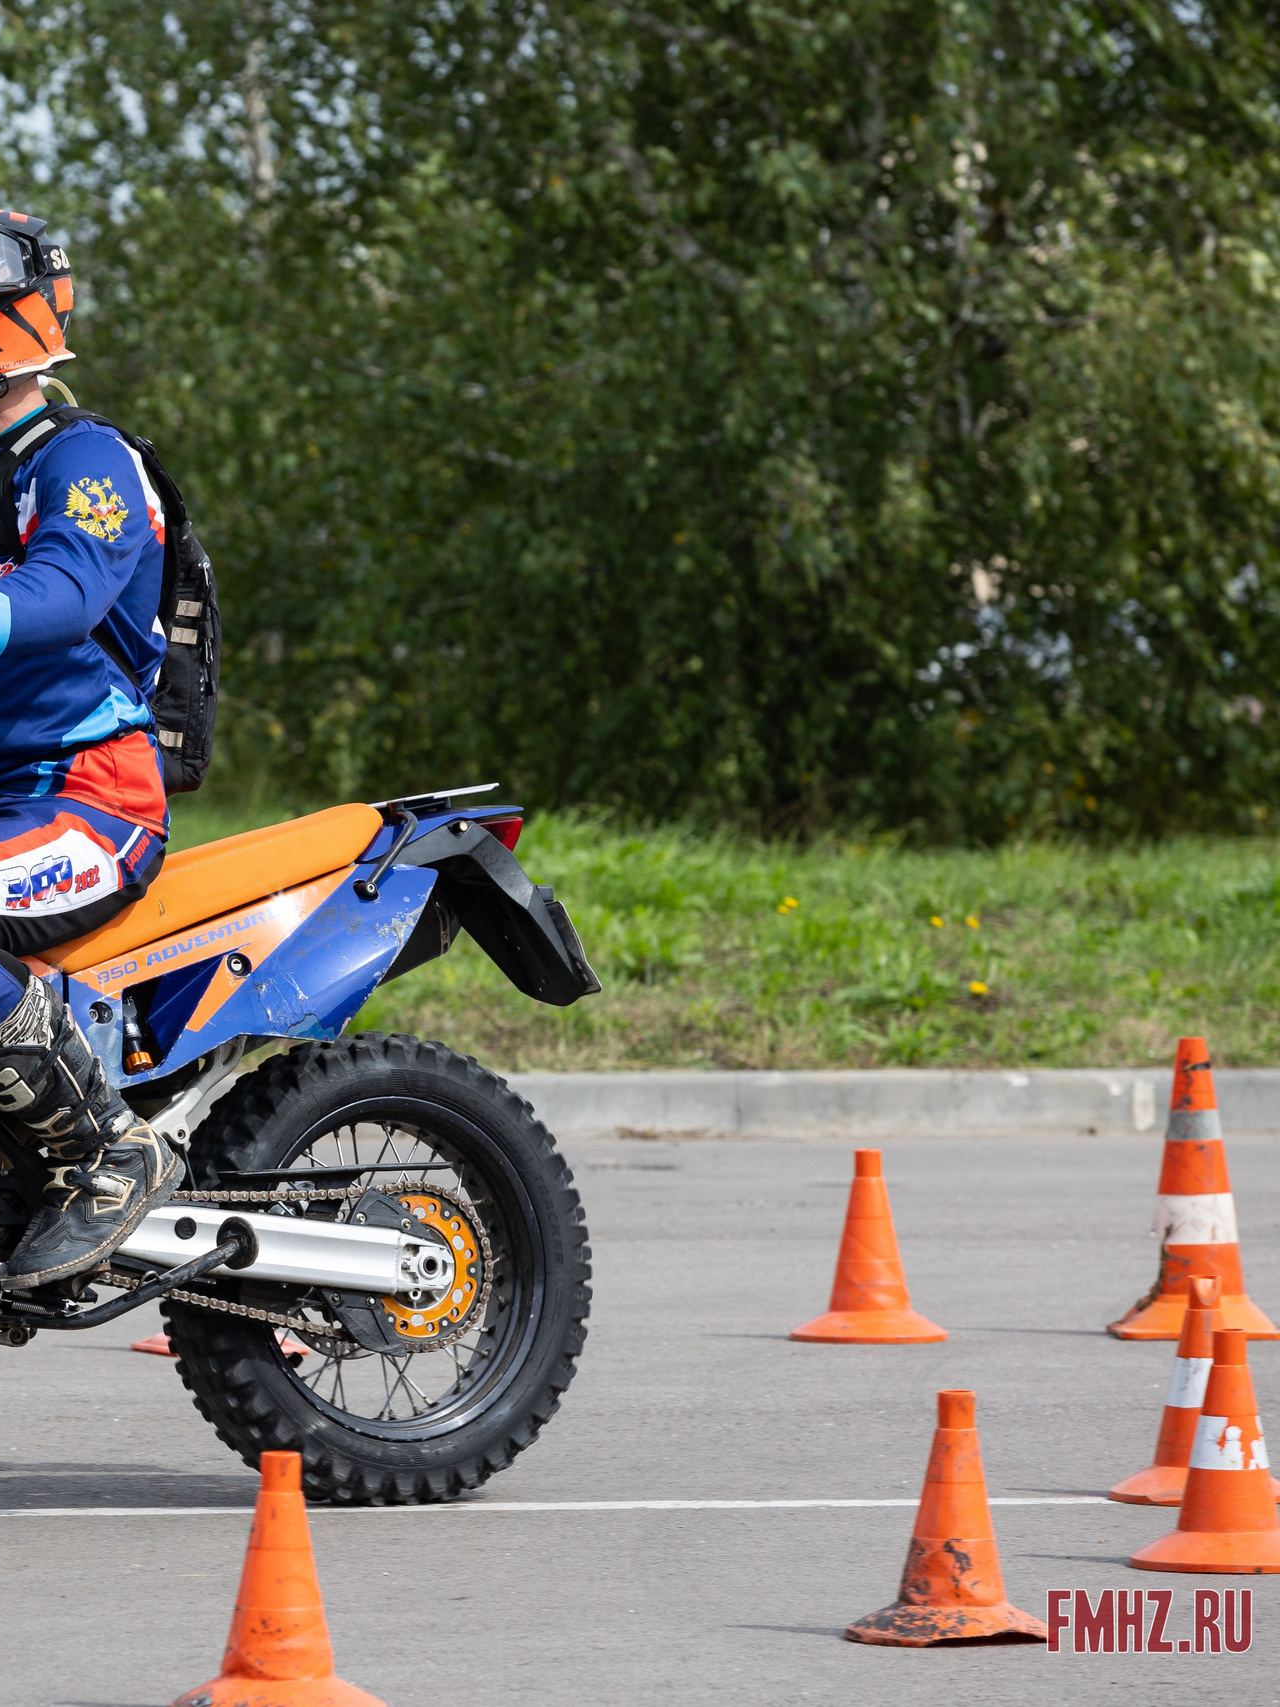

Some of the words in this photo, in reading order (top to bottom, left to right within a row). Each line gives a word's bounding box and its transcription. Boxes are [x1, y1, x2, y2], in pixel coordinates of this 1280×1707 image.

[74, 864, 101, 894] 2022
[96, 960, 138, 985] 950
[530, 1172, 564, 1264] TRACKER
